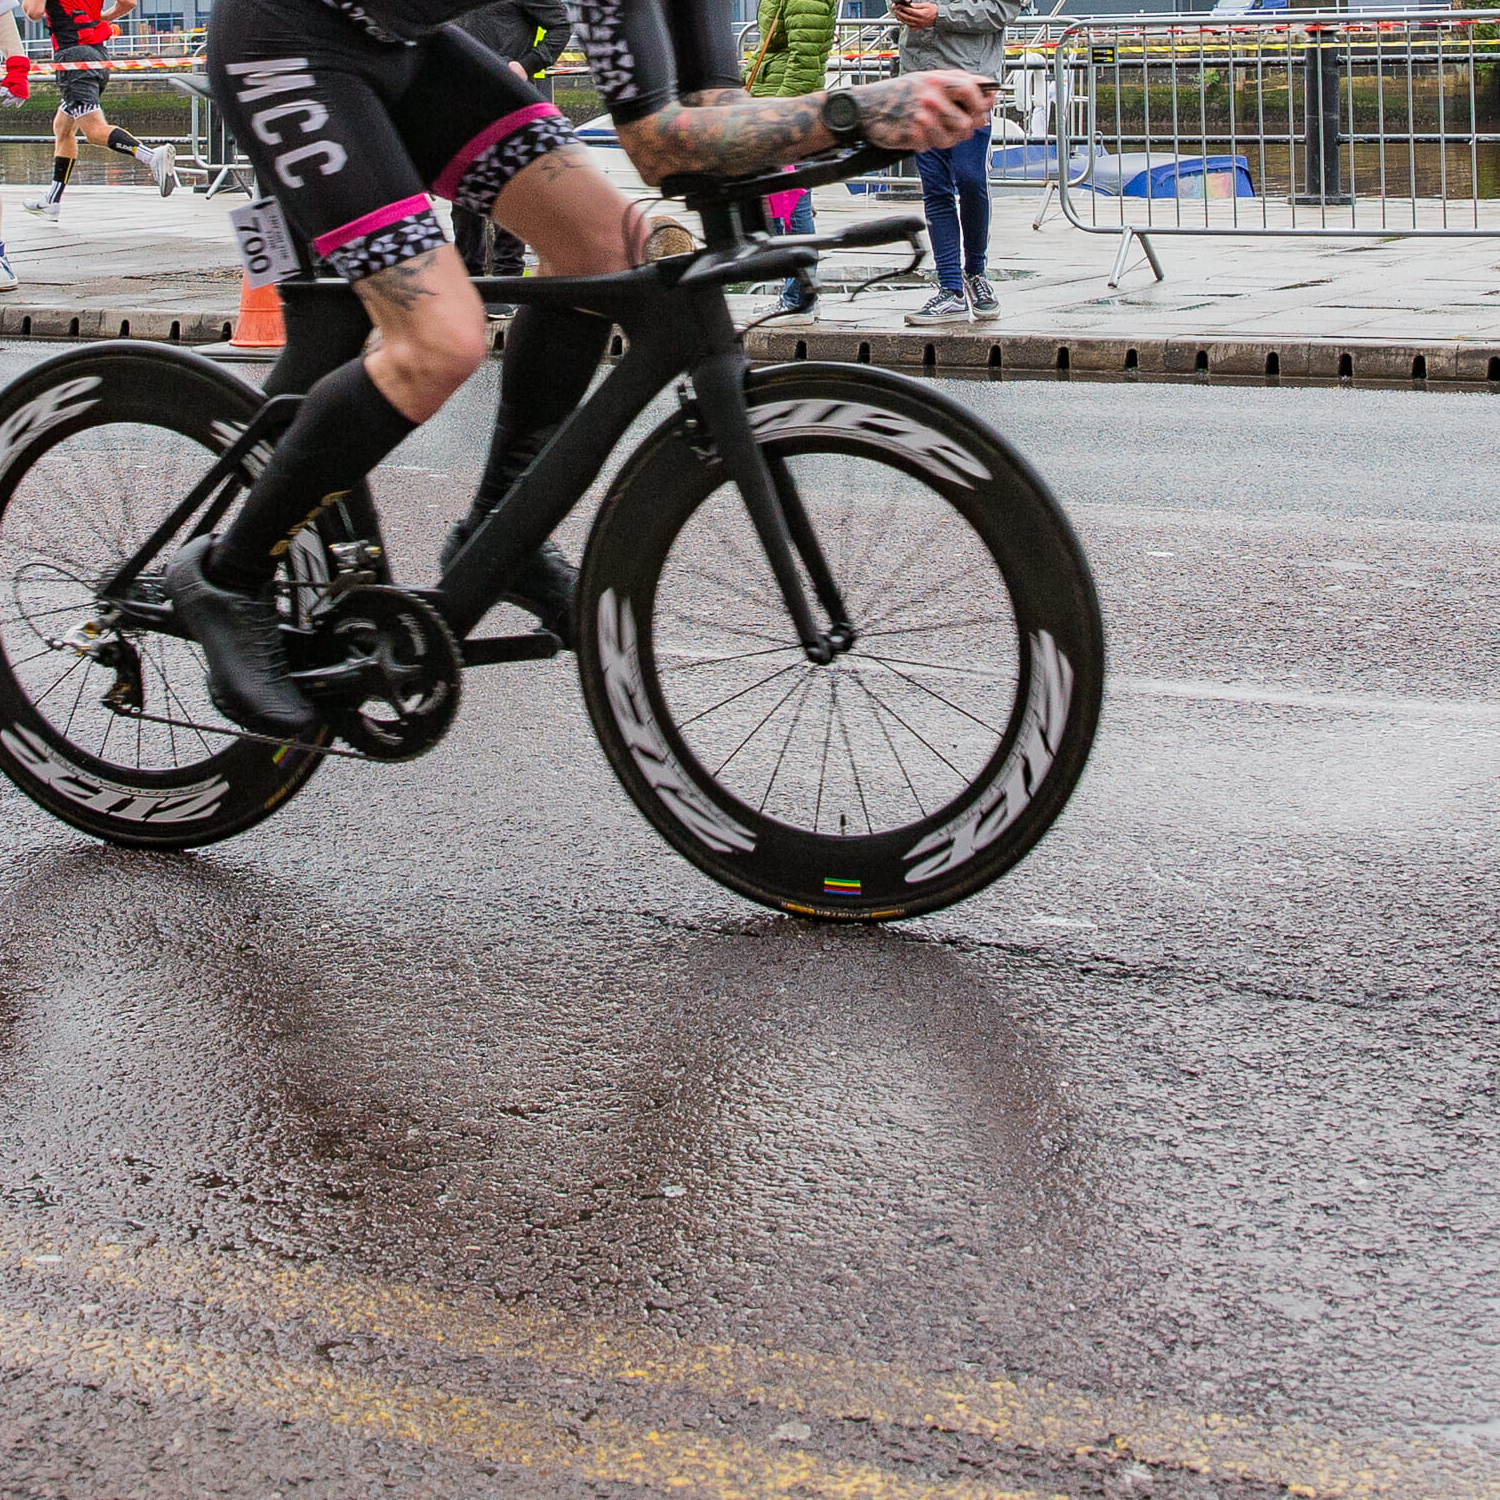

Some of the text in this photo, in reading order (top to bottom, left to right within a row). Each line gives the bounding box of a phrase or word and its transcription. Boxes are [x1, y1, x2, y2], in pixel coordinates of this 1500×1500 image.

[225, 57, 348, 189] MCC
[237, 216, 271, 274] 700
[0, 726, 230, 823] ZIPP
[598, 587, 757, 853] ZIPP
[904, 629, 1074, 883] ZIPP
